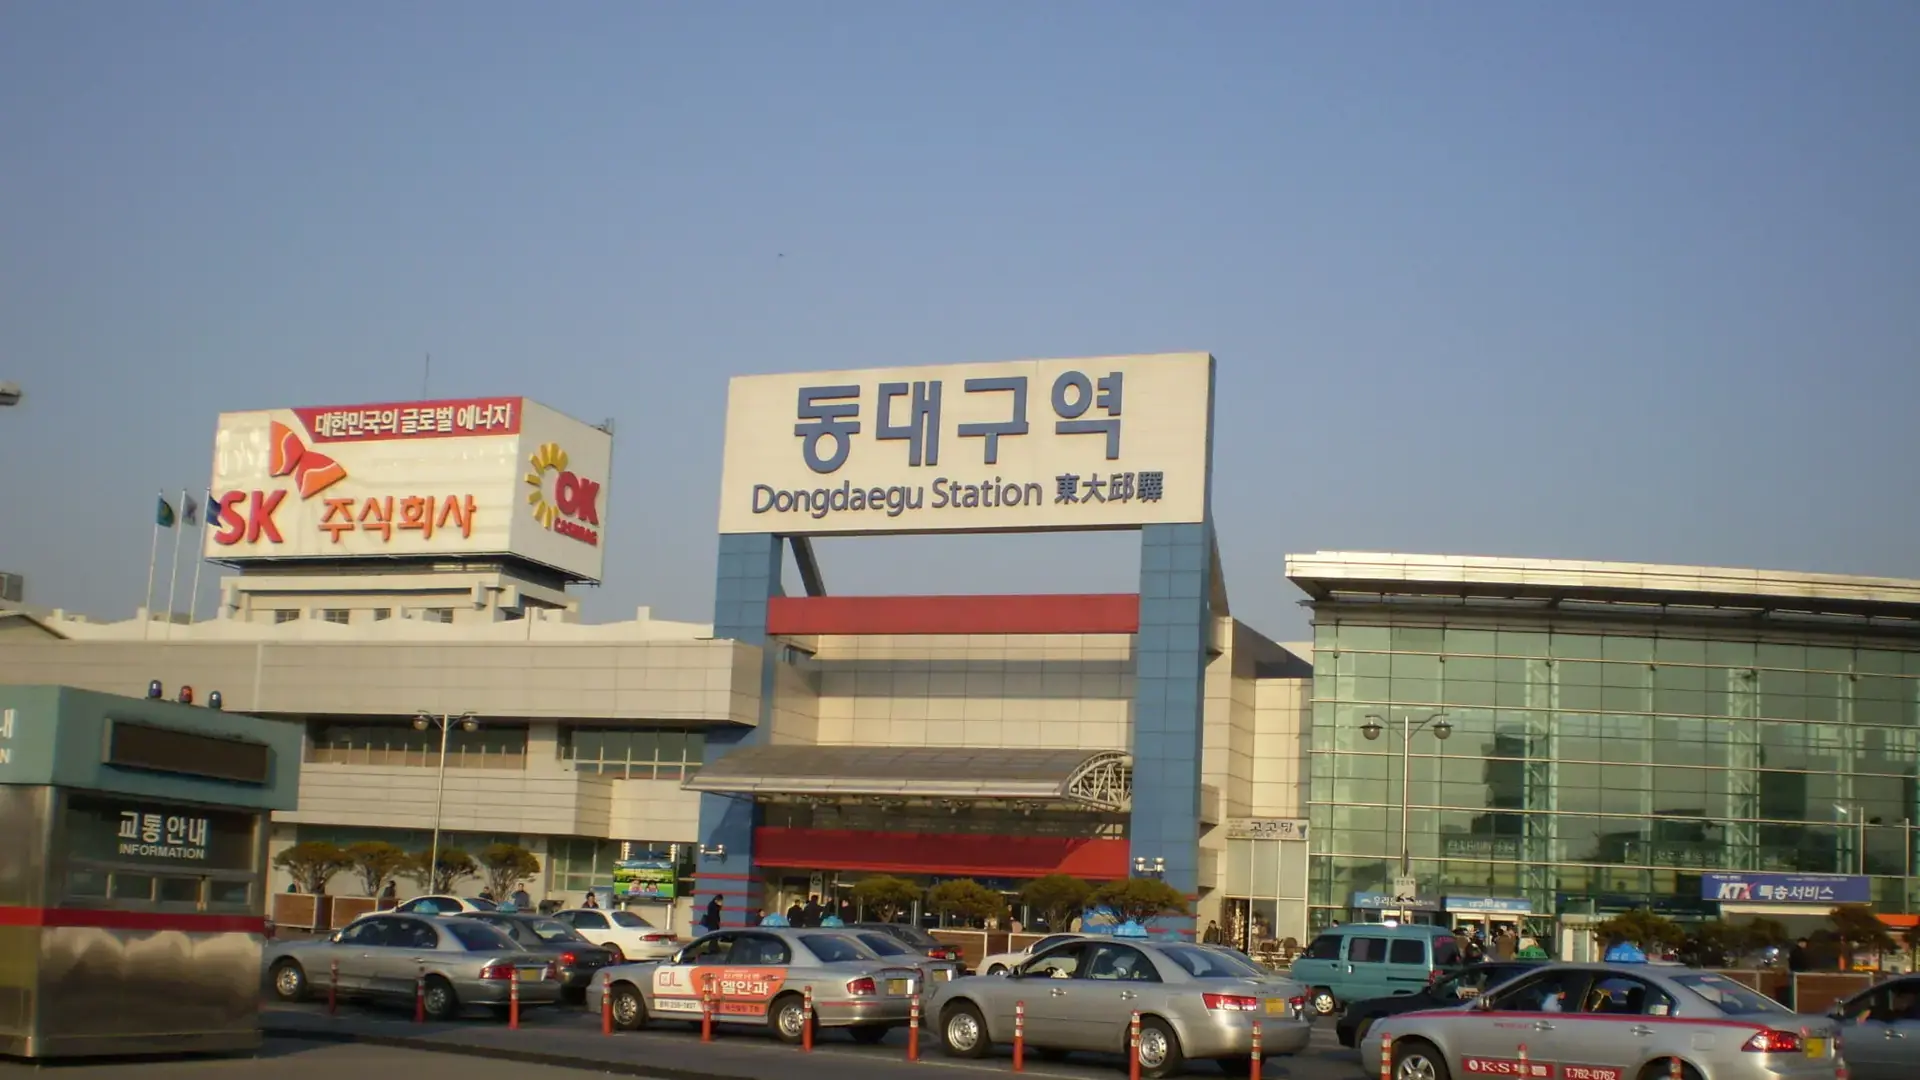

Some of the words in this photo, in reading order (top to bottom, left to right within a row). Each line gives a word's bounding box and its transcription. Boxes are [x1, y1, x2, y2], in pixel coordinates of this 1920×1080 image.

[314, 409, 399, 438] 대한민국의
[400, 407, 454, 434] 글로벌
[457, 403, 512, 430] 에너지
[794, 371, 1123, 474] 동대구역
[213, 490, 287, 545] SK
[318, 494, 477, 543] 주식회사
[555, 471, 600, 527] OK
[752, 480, 924, 518] Dongdaegu
[931, 477, 1042, 508] Station
[1054, 471, 1164, 504] 東大邱驛
[118, 811, 207, 846] 교통안내
[119, 843, 205, 859] INFORMATION
